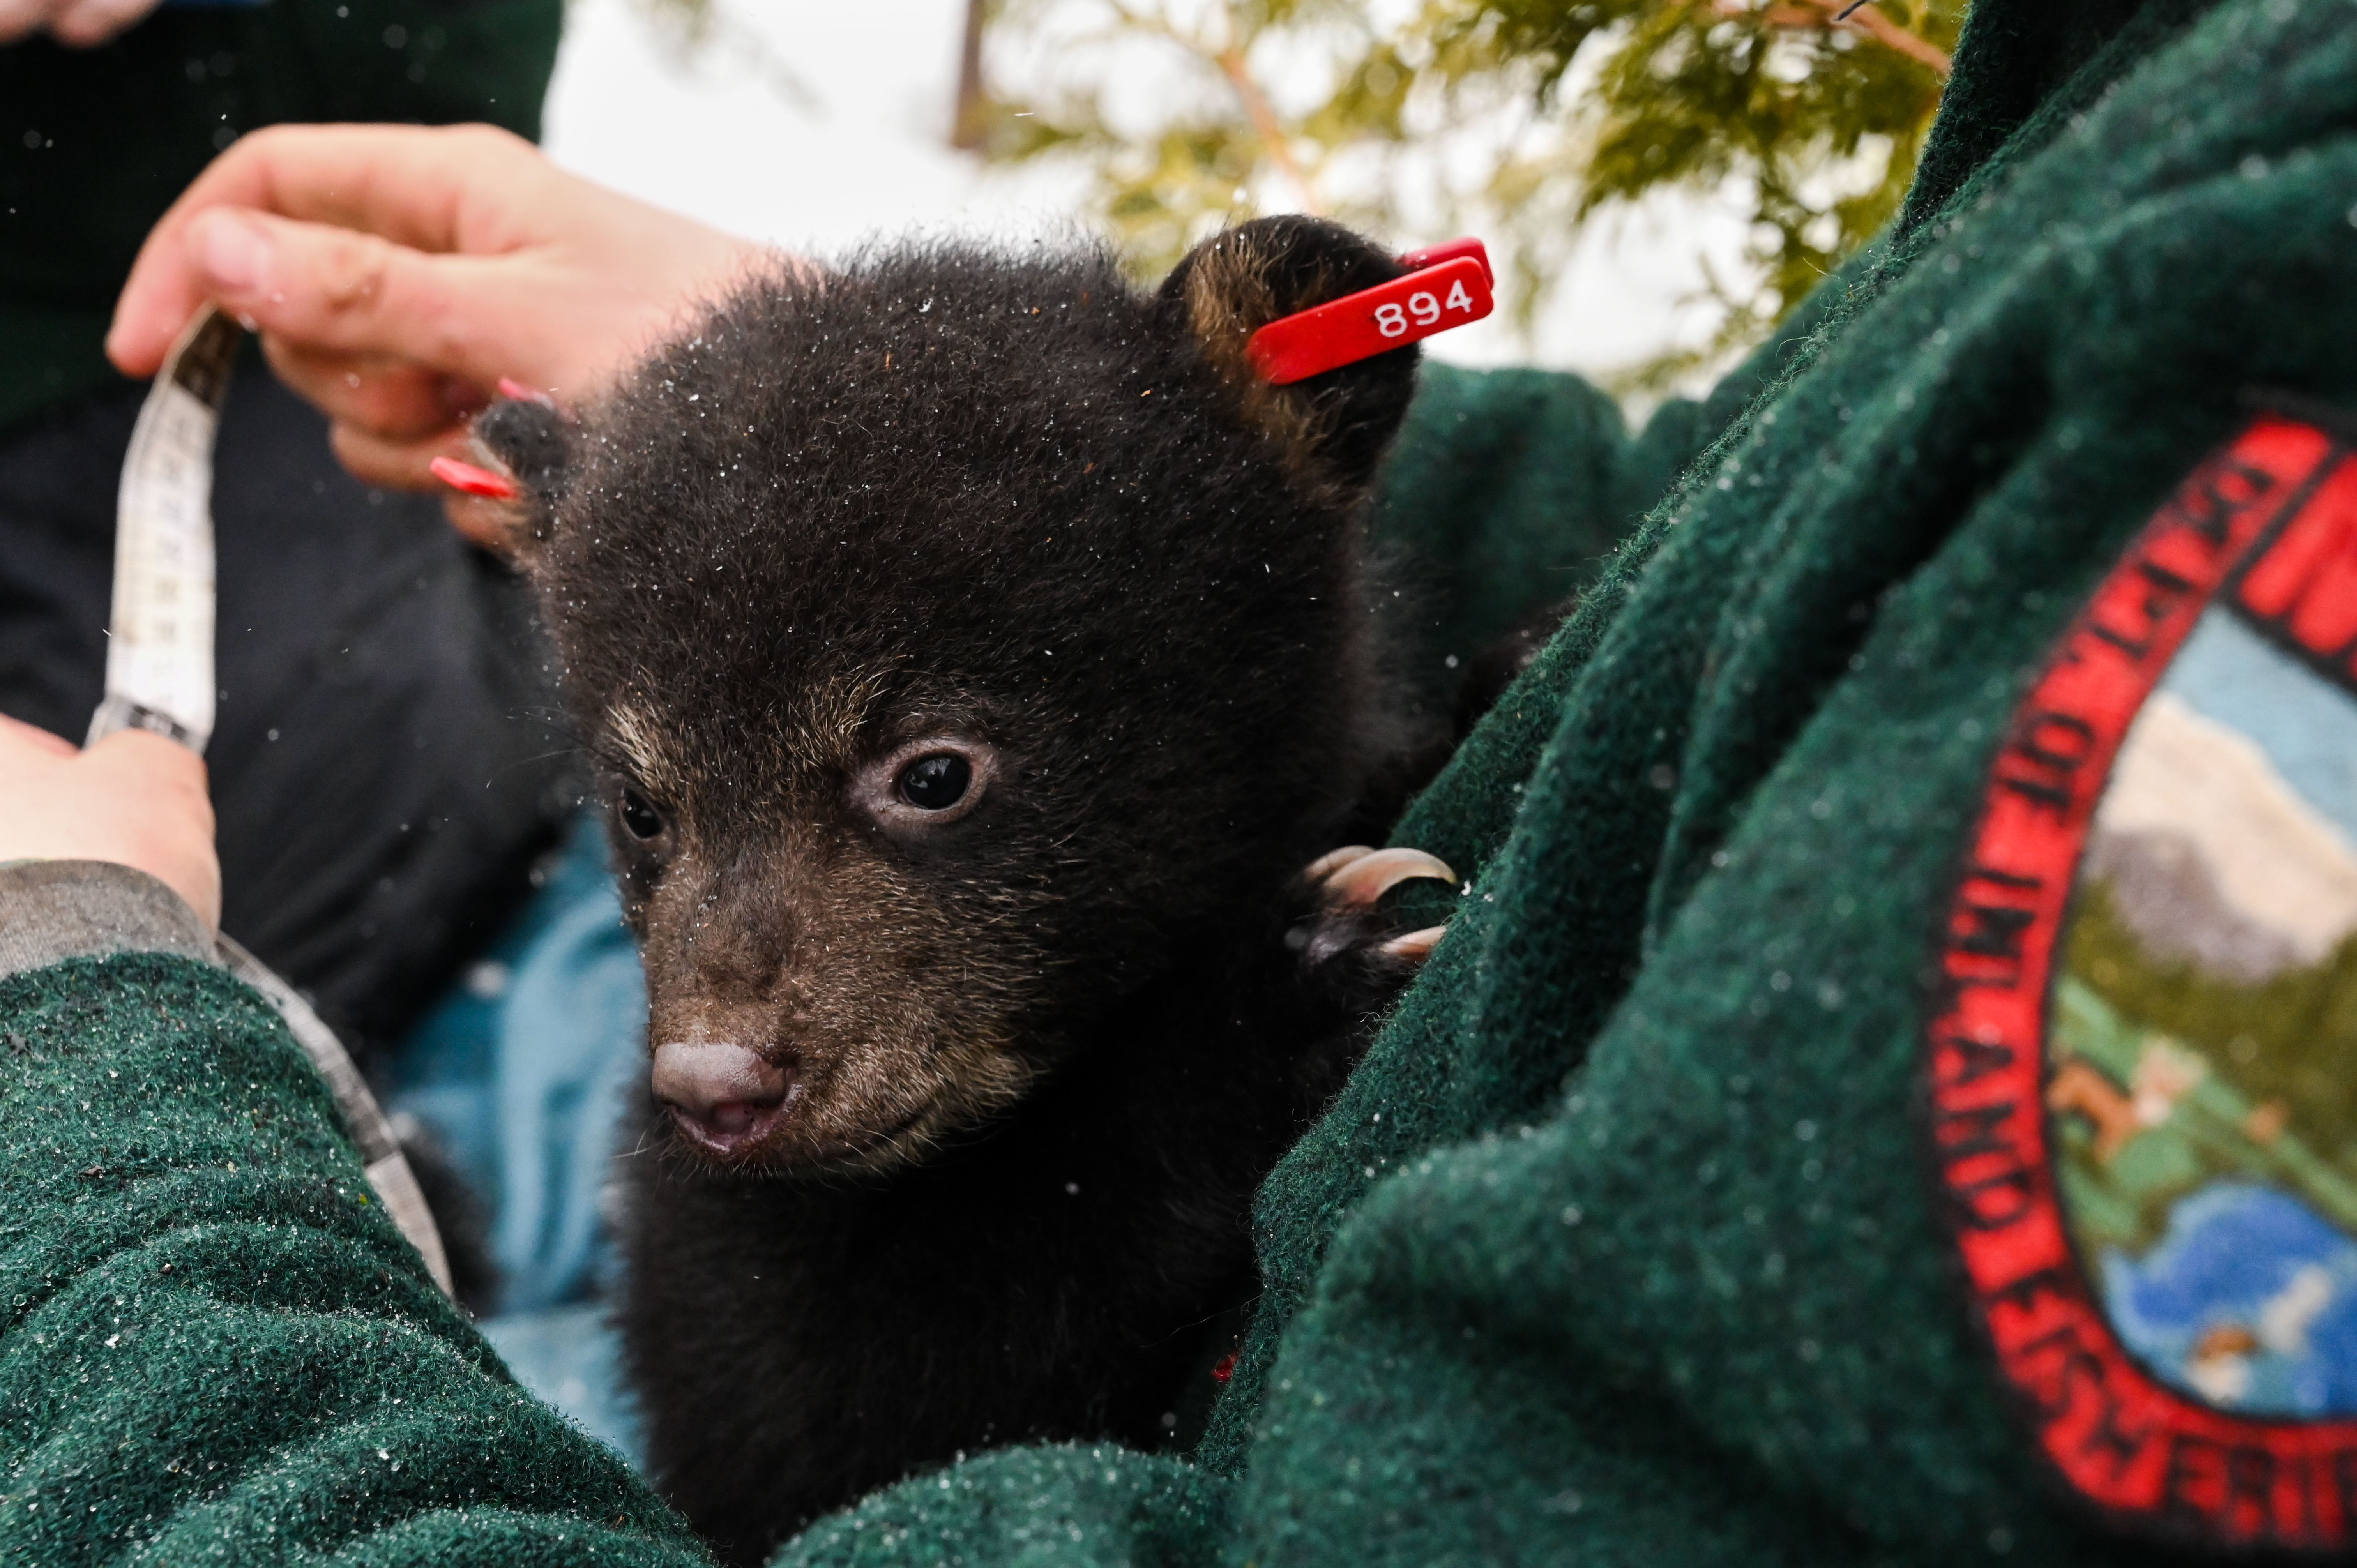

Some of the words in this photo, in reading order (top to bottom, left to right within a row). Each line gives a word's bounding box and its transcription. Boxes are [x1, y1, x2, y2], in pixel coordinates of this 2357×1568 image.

[1374, 278, 1473, 338] 894
[1995, 712, 2095, 826] OF
[1934, 866, 2044, 1230] INLAND
